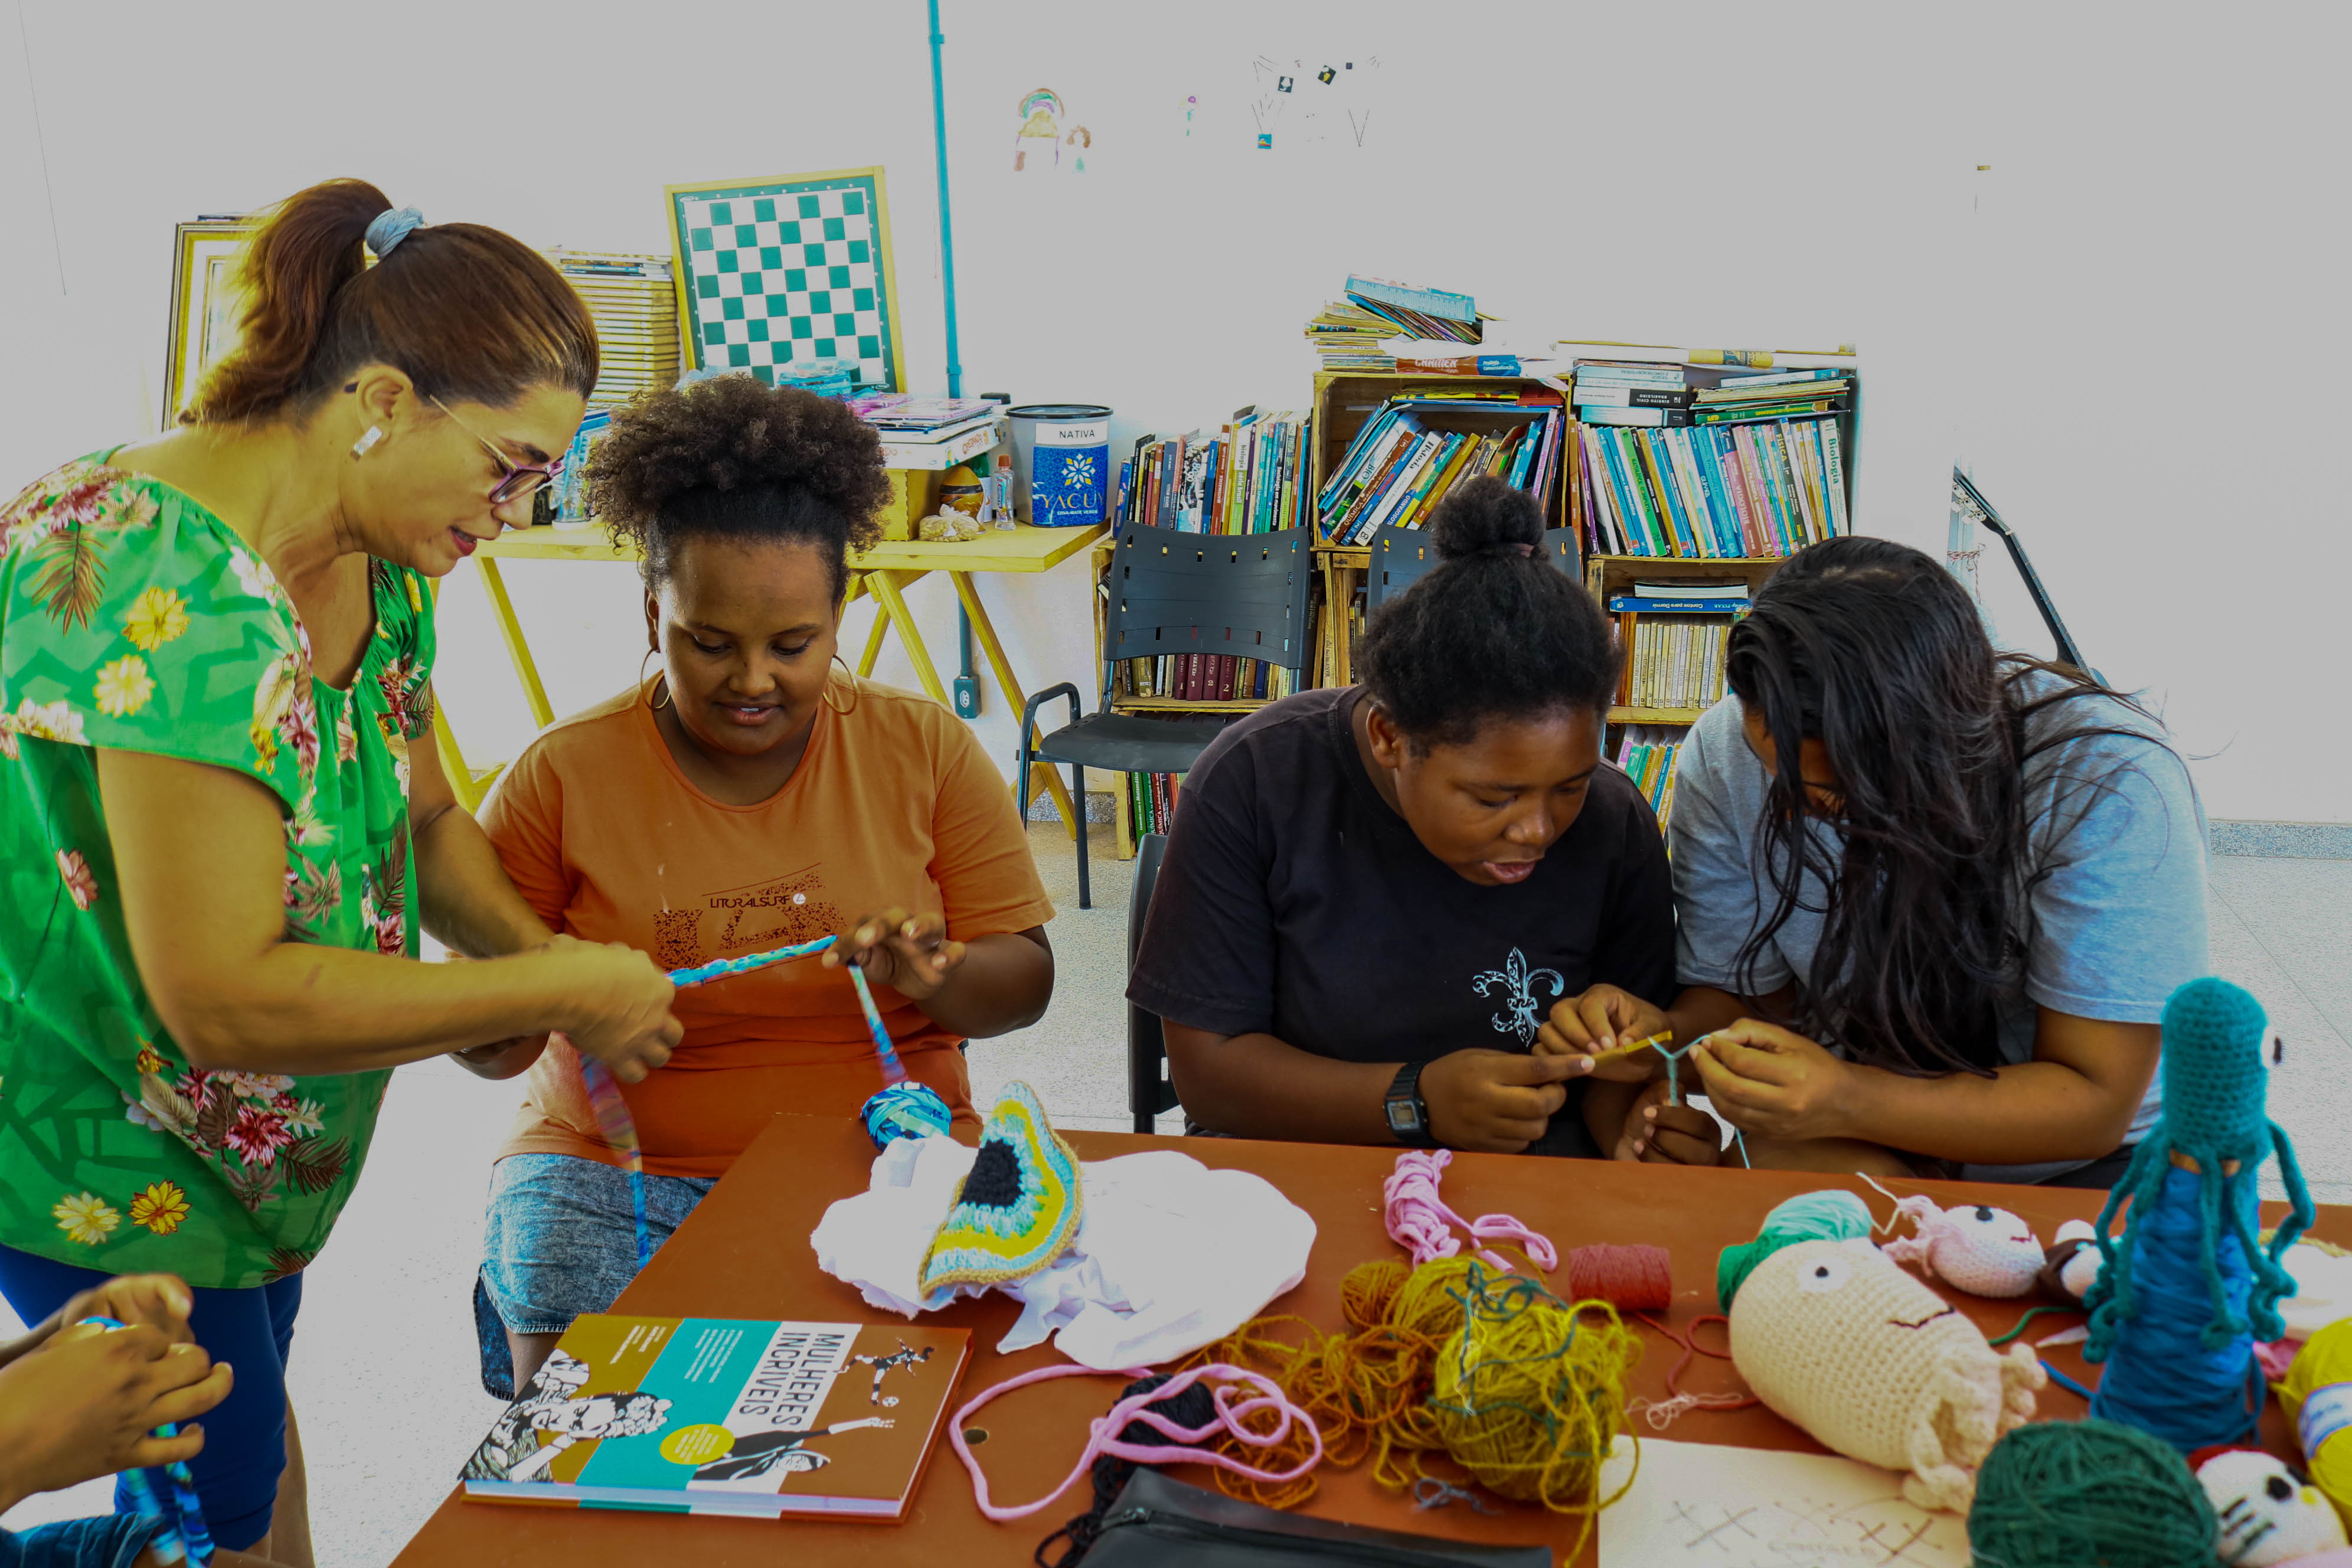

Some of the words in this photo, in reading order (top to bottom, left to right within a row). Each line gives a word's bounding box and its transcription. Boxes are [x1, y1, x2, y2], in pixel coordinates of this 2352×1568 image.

[1060, 430, 1095, 439] NATIVA
[1775, 433, 1788, 462] FÍSICA
[1237, 444, 1247, 468] biologia
[1828, 437, 1842, 484] Biologia
[1274, 466, 1282, 491] Sociologia
[1360, 463, 1376, 481] BIO
[1236, 486, 1244, 502] brasil
[1623, 485, 1636, 515] Matemática
[1734, 485, 1750, 524] BIOLOGIA
[1341, 499, 1364, 526] QUÍMICA
[710, 895, 790, 909] LITORALSURF
[739, 1332, 811, 1415] INCRÍVEIS
[771, 1334, 845, 1426] MULHERES
